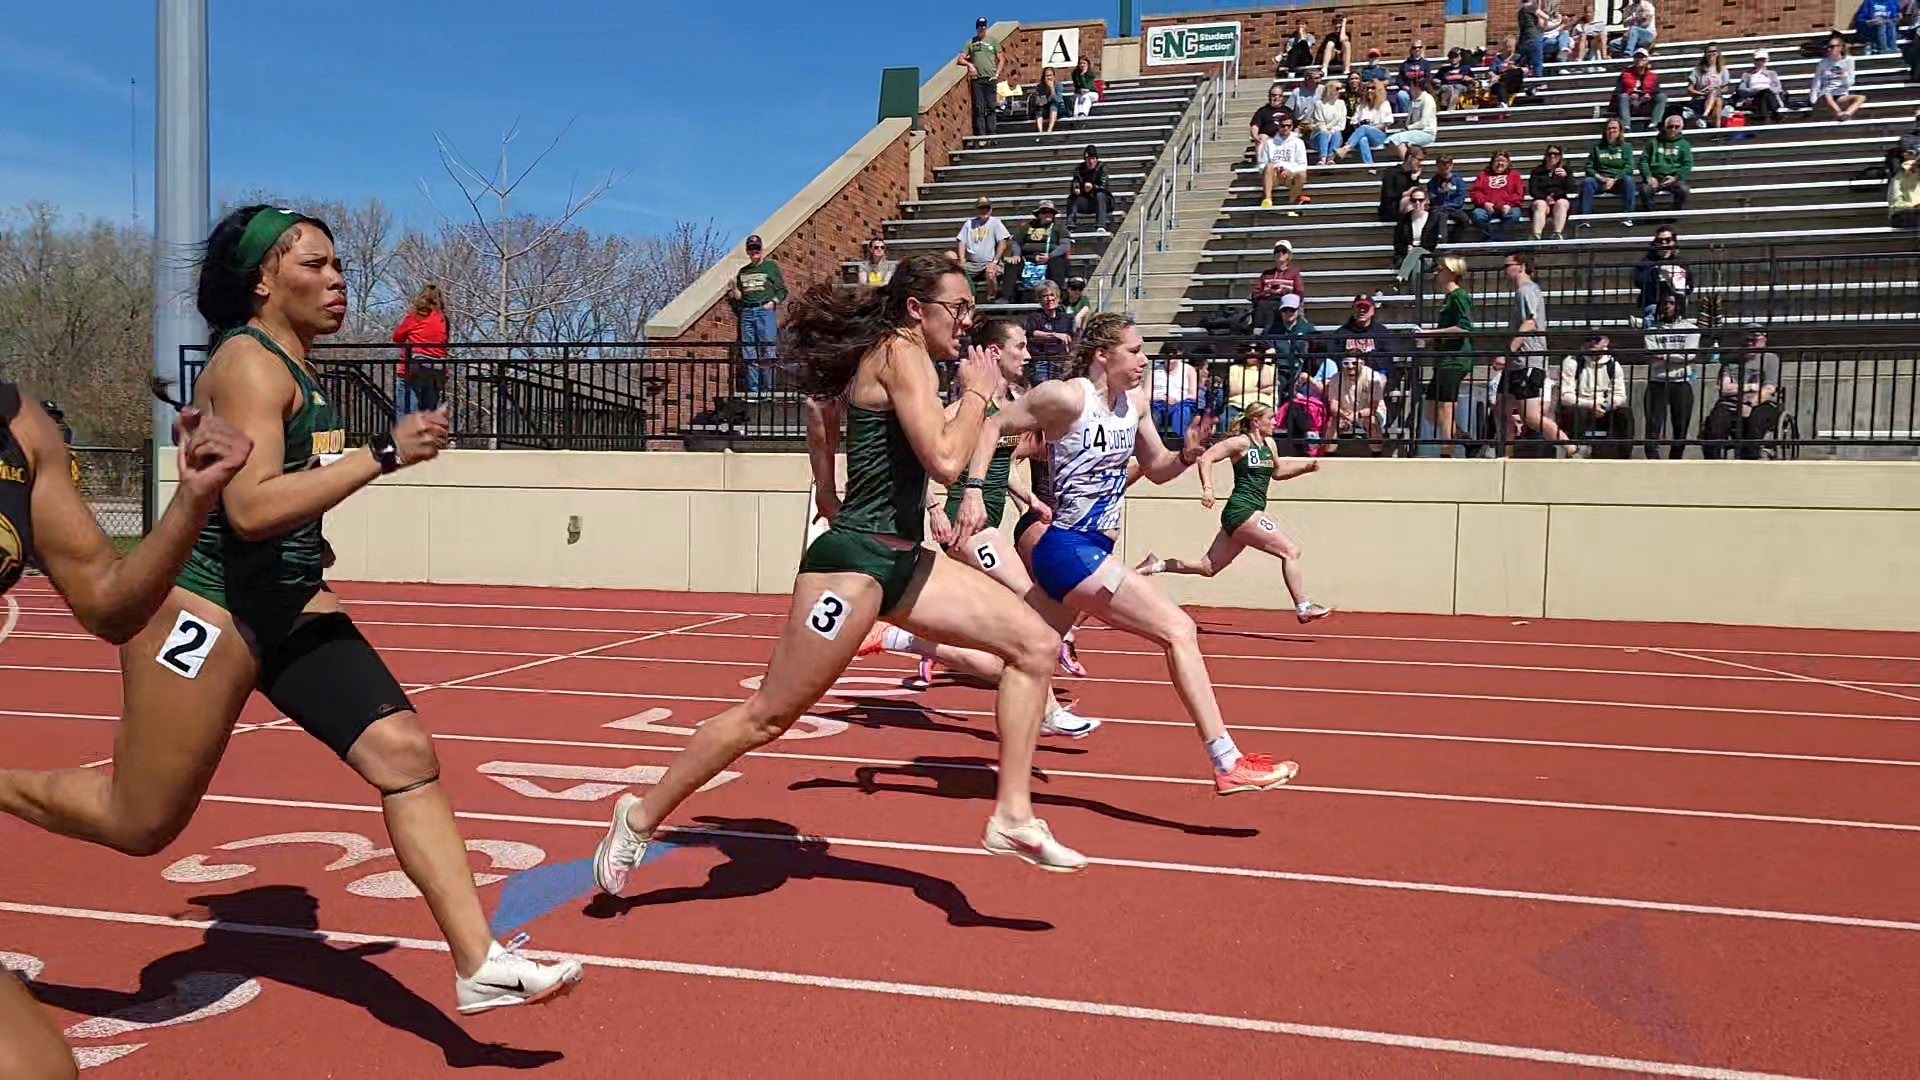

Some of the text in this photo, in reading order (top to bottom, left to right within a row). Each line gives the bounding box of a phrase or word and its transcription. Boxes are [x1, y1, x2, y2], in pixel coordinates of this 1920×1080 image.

[1606, 0, 1625, 26] B
[1048, 34, 1072, 63] A
[1153, 30, 1197, 58] SNC
[1199, 32, 1234, 41] Student
[1093, 424, 1107, 453] 4
[1249, 450, 1259, 465] 8
[1260, 519, 1274, 531] 8
[977, 546, 996, 569] 5
[812, 597, 844, 633] 3
[163, 620, 208, 673] 2
